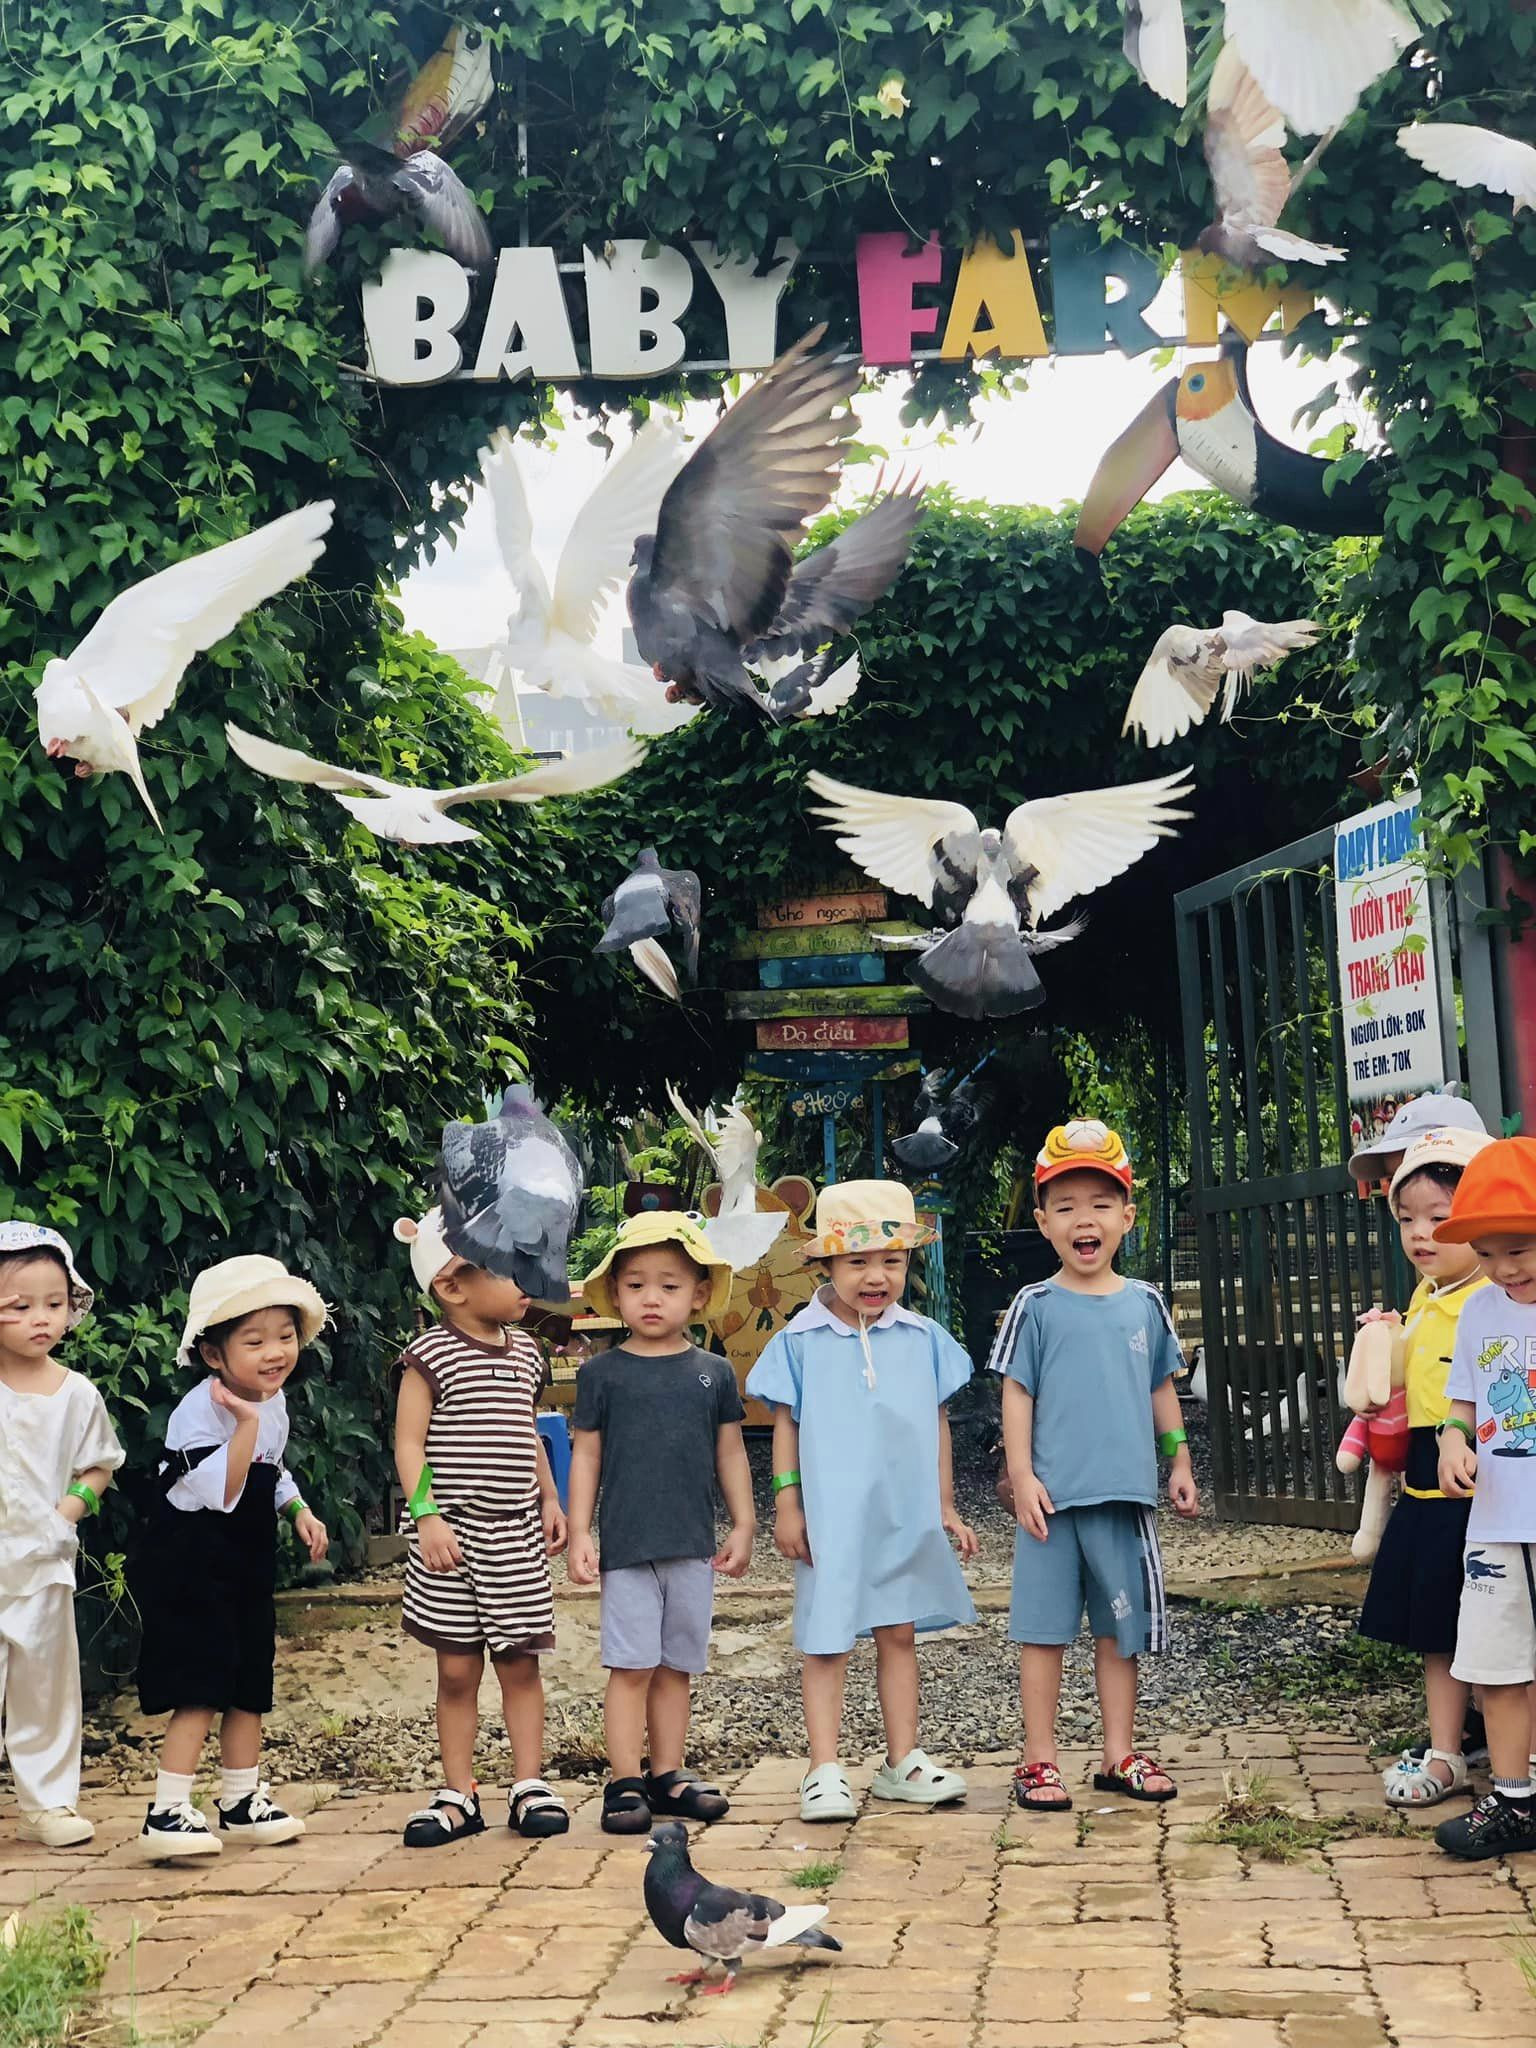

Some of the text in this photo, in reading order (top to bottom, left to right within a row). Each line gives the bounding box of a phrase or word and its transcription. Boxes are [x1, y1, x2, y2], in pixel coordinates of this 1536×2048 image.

[361, 237, 802, 387] BABY
[1337, 822, 1376, 882] BABY
[1350, 879, 1413, 943] VƯỜN THÚ
[1348, 954, 1390, 1000] TRANG
[1351, 1009, 1426, 1047] NGƯỜI LỚN: 80K
[1353, 1049, 1412, 1081] TRẺ EM: 70K
